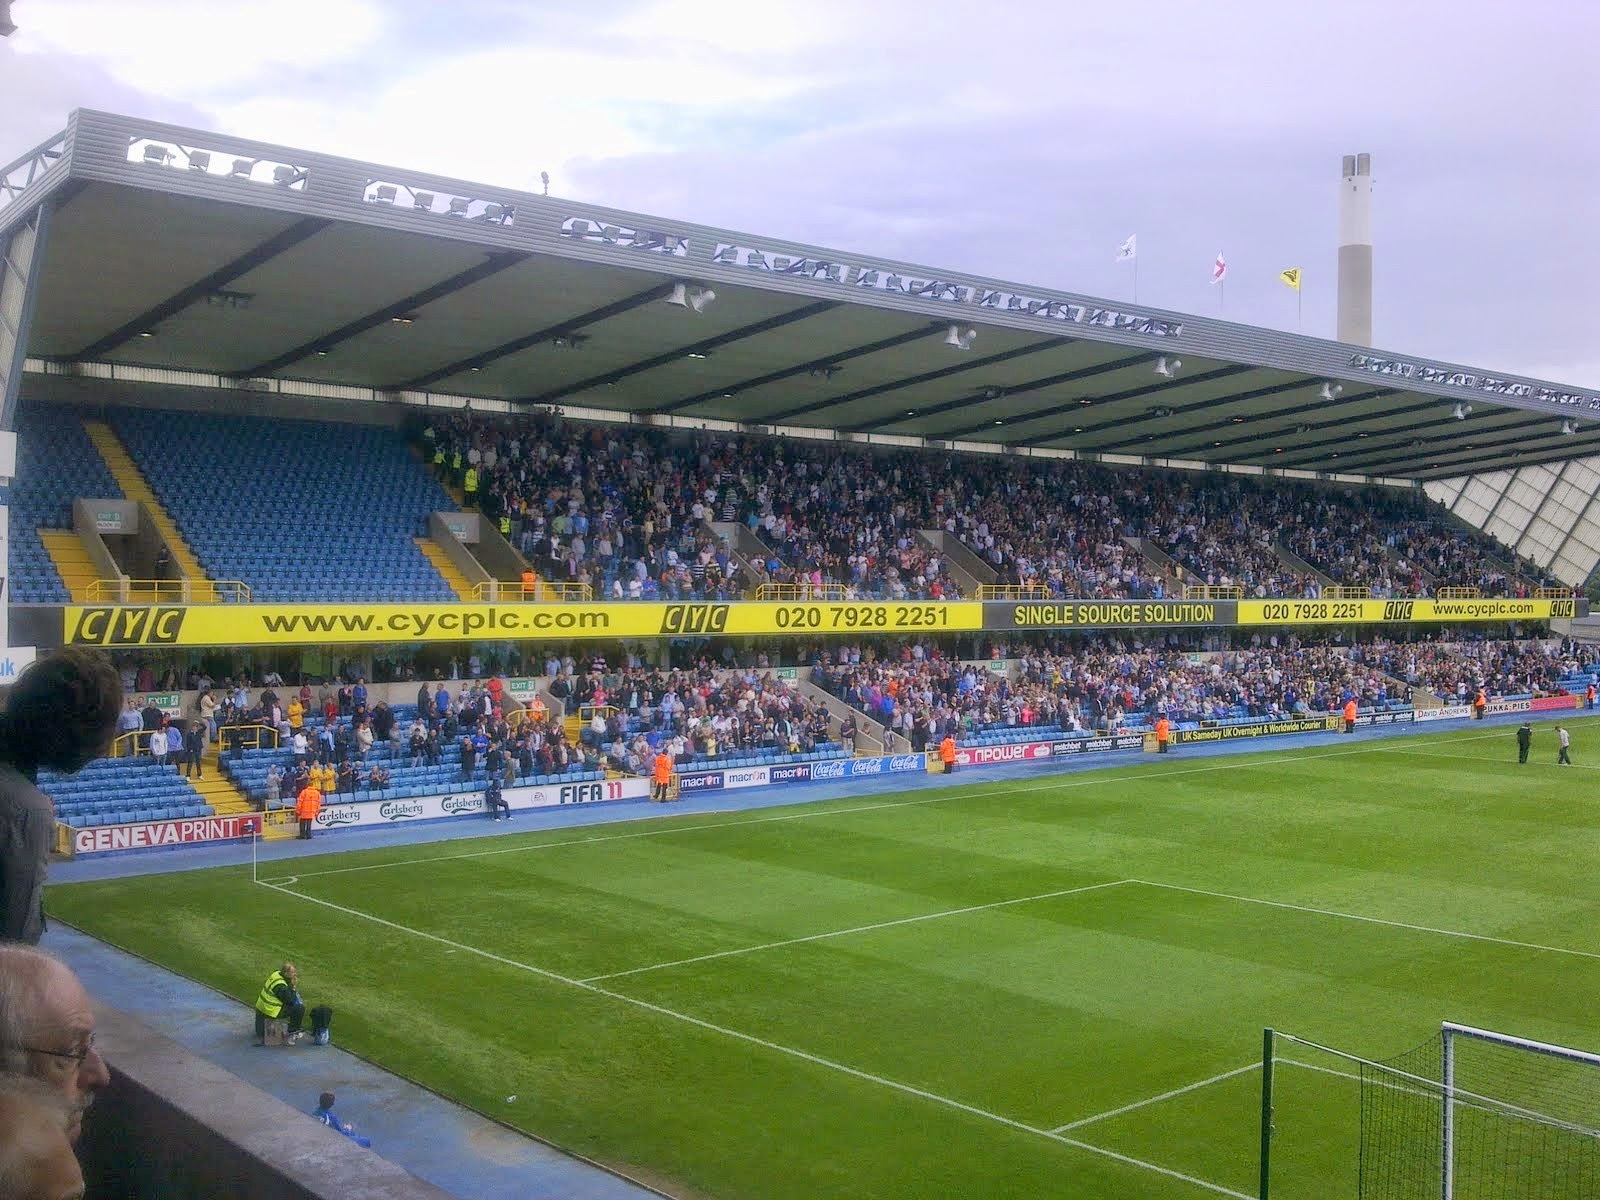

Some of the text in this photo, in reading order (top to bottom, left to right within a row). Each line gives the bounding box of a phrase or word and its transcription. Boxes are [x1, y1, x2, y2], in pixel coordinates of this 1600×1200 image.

[775, 606, 948, 628] 020 7928 2251
[1014, 603, 1214, 625] SINGLE SOURCE SOLUTION
[1263, 603, 1363, 620] 020 7928 2251
[1385, 602, 1413, 619] CYC
[1433, 602, 1534, 617] www.cycplc.com
[1550, 601, 1573, 616] CYC
[77, 609, 182, 641] CYC
[262, 608, 610, 636] www.cycplc.com
[662, 606, 728, 632] CYC
[511, 682, 527, 690] EXIT
[1418, 709, 1437, 718] DAVID
[1438, 707, 1468, 717] ANDREWS
[1182, 731, 1192, 741] UK
[1192, 729, 1222, 740] Sameday
[1222, 727, 1232, 738] UK
[1232, 725, 1263, 737] Overnight
[1263, 724, 1269, 733] &
[1269, 721, 1300, 733] Worldwide
[1300, 720, 1321, 731] Courier
[681, 775, 721, 788] macron
[729, 770, 766, 782] macron
[773, 766, 810, 779] macron
[560, 781, 622, 804] FIFA 11
[380, 801, 424, 821] Carlsberg
[441, 796, 483, 814] Carlsberg
[316, 807, 361, 827] Carlsberg
